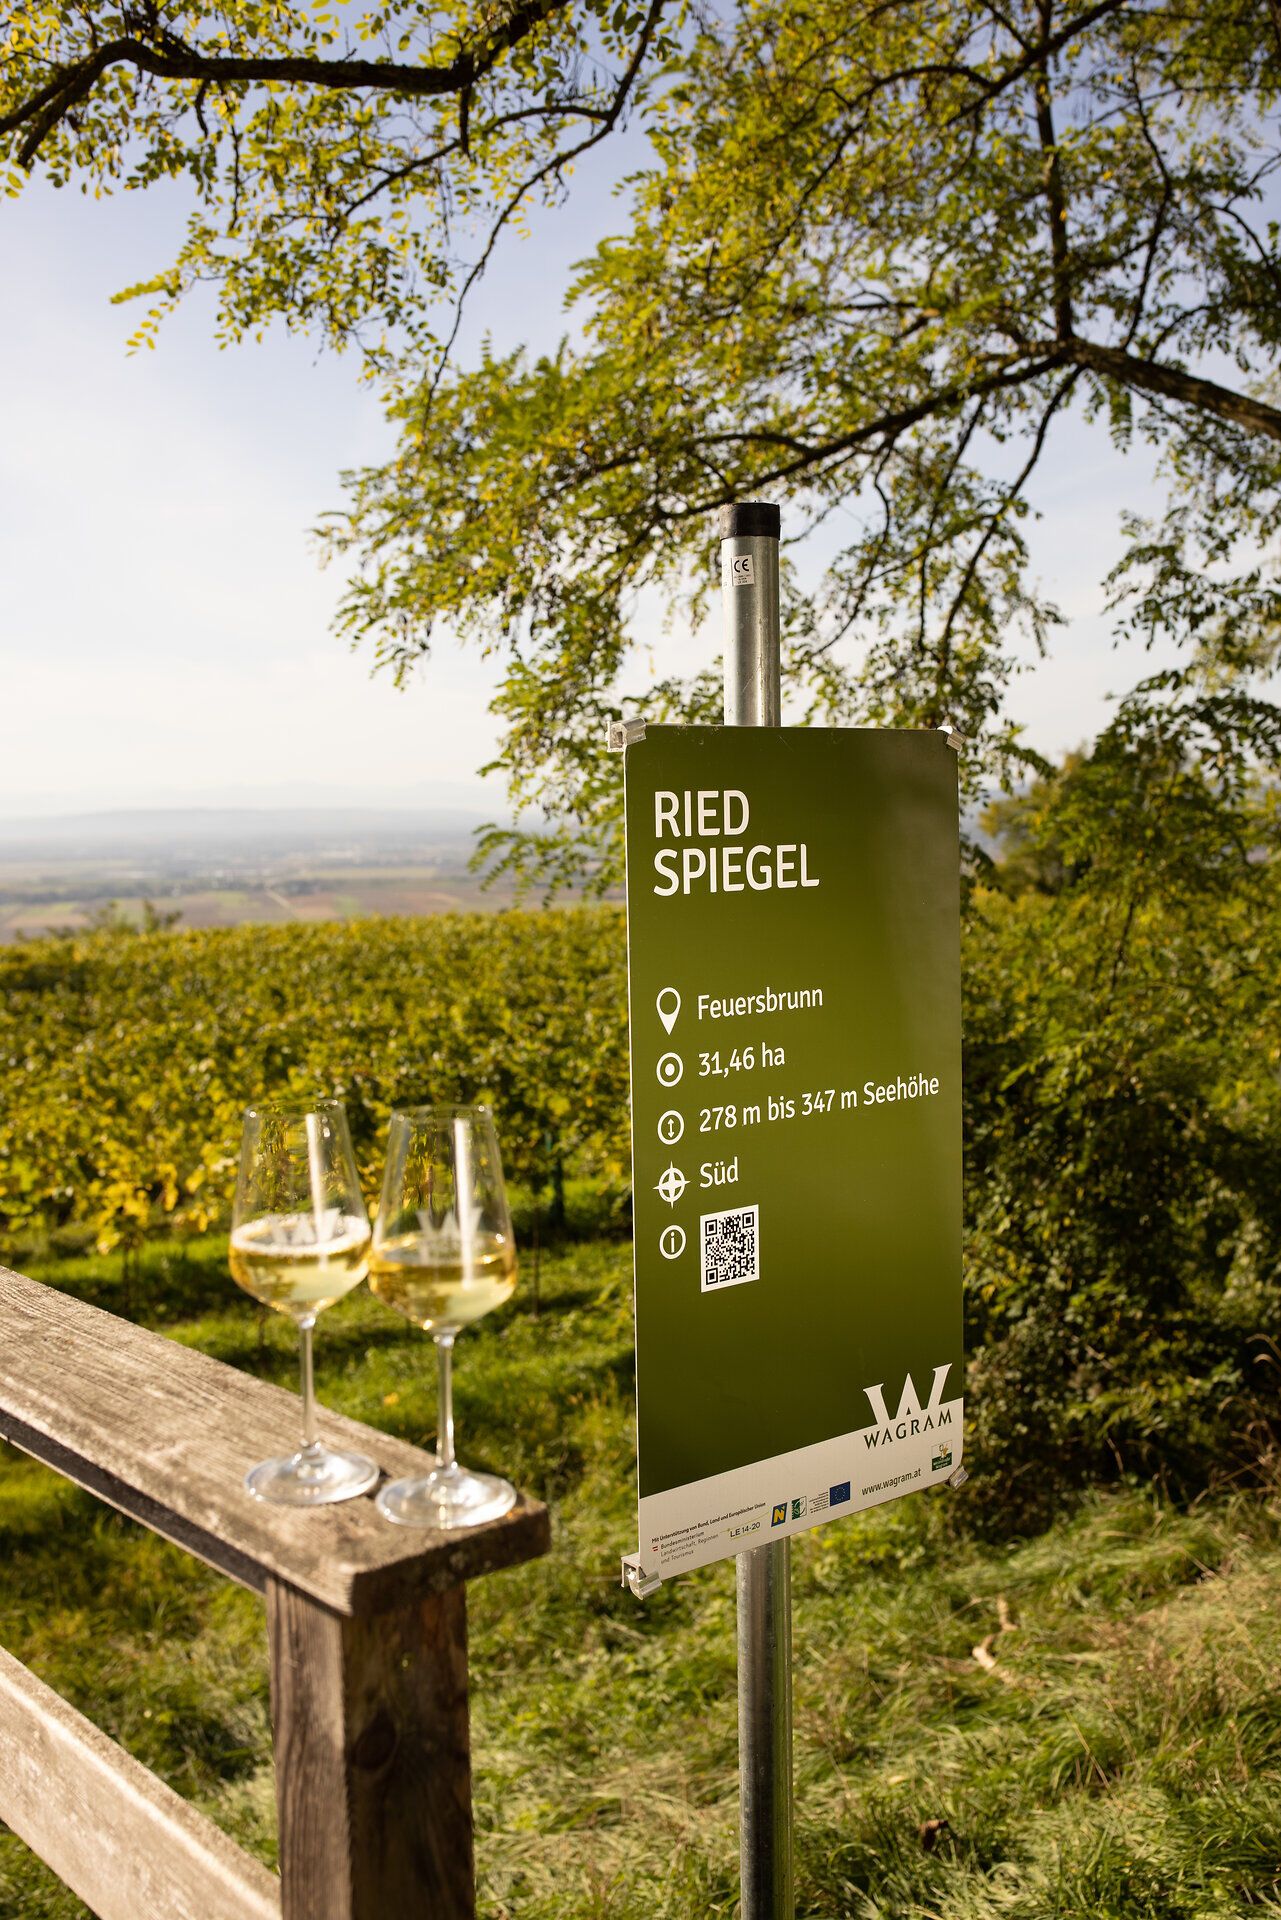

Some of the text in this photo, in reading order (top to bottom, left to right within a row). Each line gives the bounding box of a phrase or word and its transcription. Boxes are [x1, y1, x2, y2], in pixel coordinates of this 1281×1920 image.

[655, 789, 750, 838] RIED
[653, 843, 820, 897] SPIEGEL
[697, 986, 824, 1020] Feuersbrunn
[698, 1041, 786, 1078] 31,46 ha
[699, 1072, 940, 1133] 278 m bis 347 m Seehöhe
[699, 1156, 739, 1188] Süd
[863, 1408, 953, 1450] WAGRAM
[861, 1468, 922, 1496] www.wagram.at
[730, 1521, 761, 1538] LE 14-20
